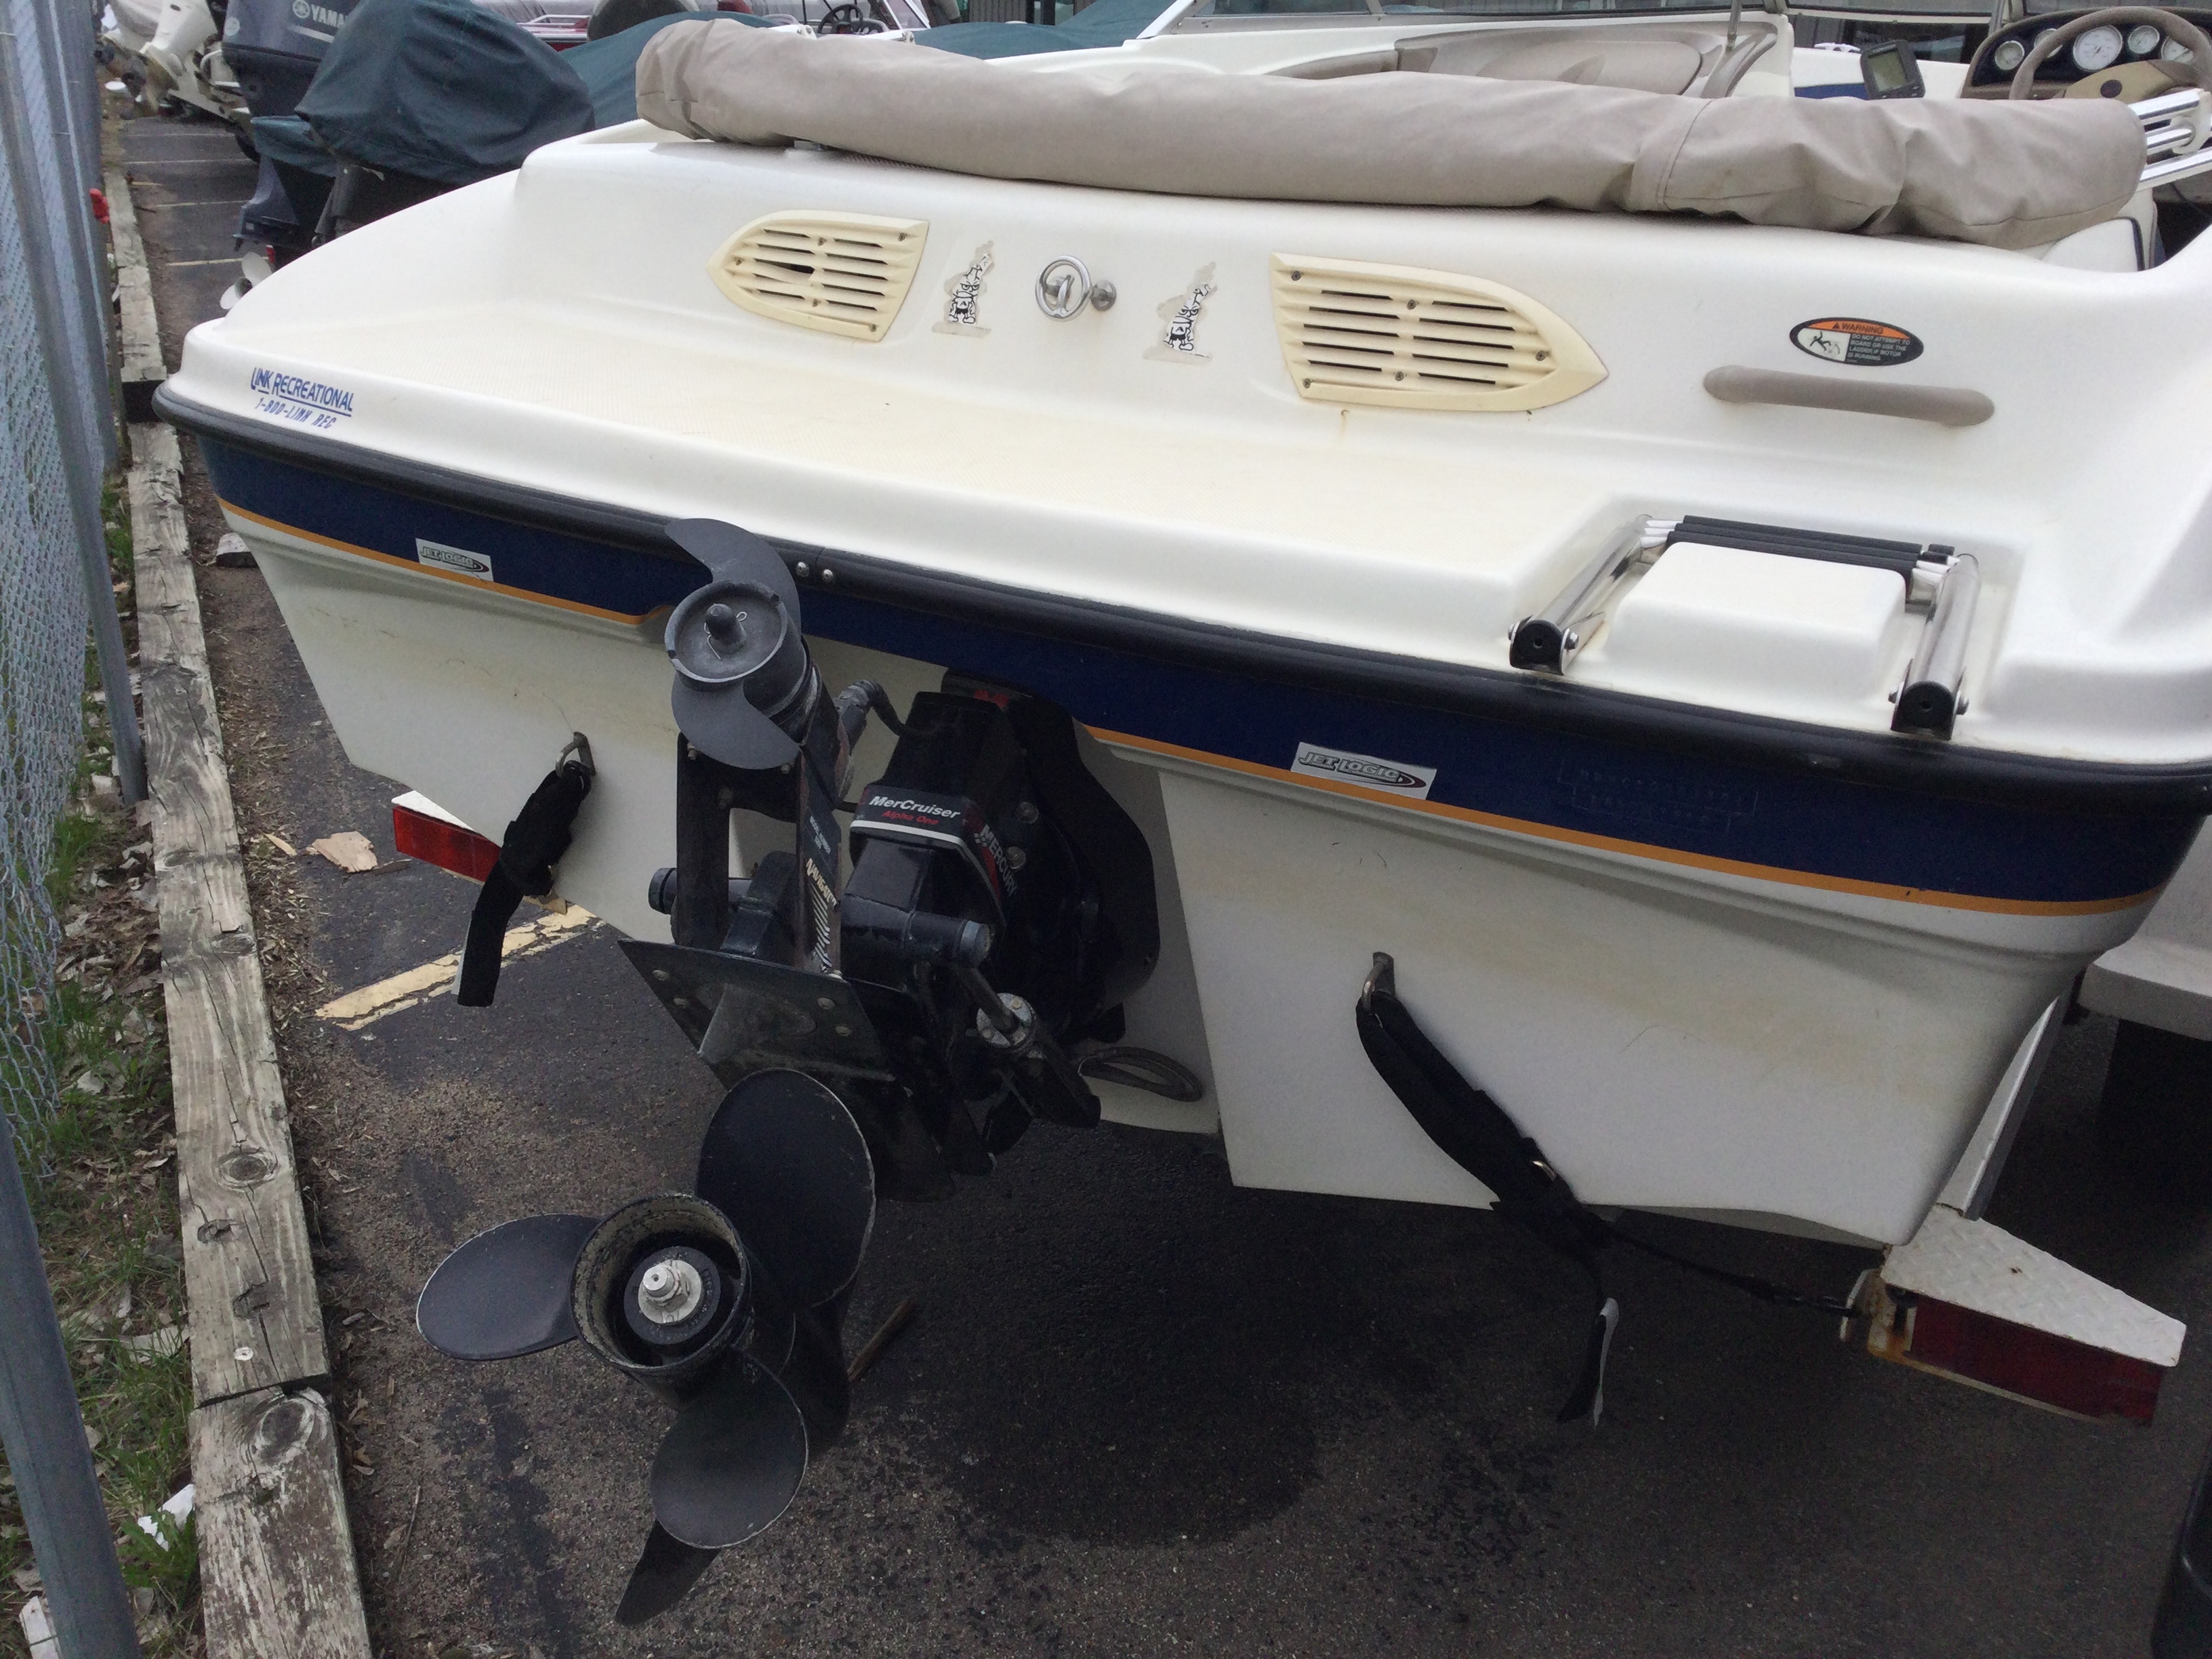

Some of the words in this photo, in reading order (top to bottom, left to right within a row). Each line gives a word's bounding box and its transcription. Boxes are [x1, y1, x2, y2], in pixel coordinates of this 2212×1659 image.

[311, 4, 344, 28] YAMA
[1842, 323, 1884, 334] WARNING
[251, 367, 274, 390] LINK
[272, 373, 354, 412] RECREATIONAL
[255, 397, 312, 423] 1-800-LINK
[311, 413, 337, 429] REC
[420, 546, 441, 561] JET
[1298, 752, 1340, 771] JET
[1336, 759, 1401, 783] LOGIC
[869, 796, 961, 819] MerCruiser
[882, 811, 914, 821] Alpha
[916, 815, 939, 825] One
[980, 824, 1018, 897] MERCURY
